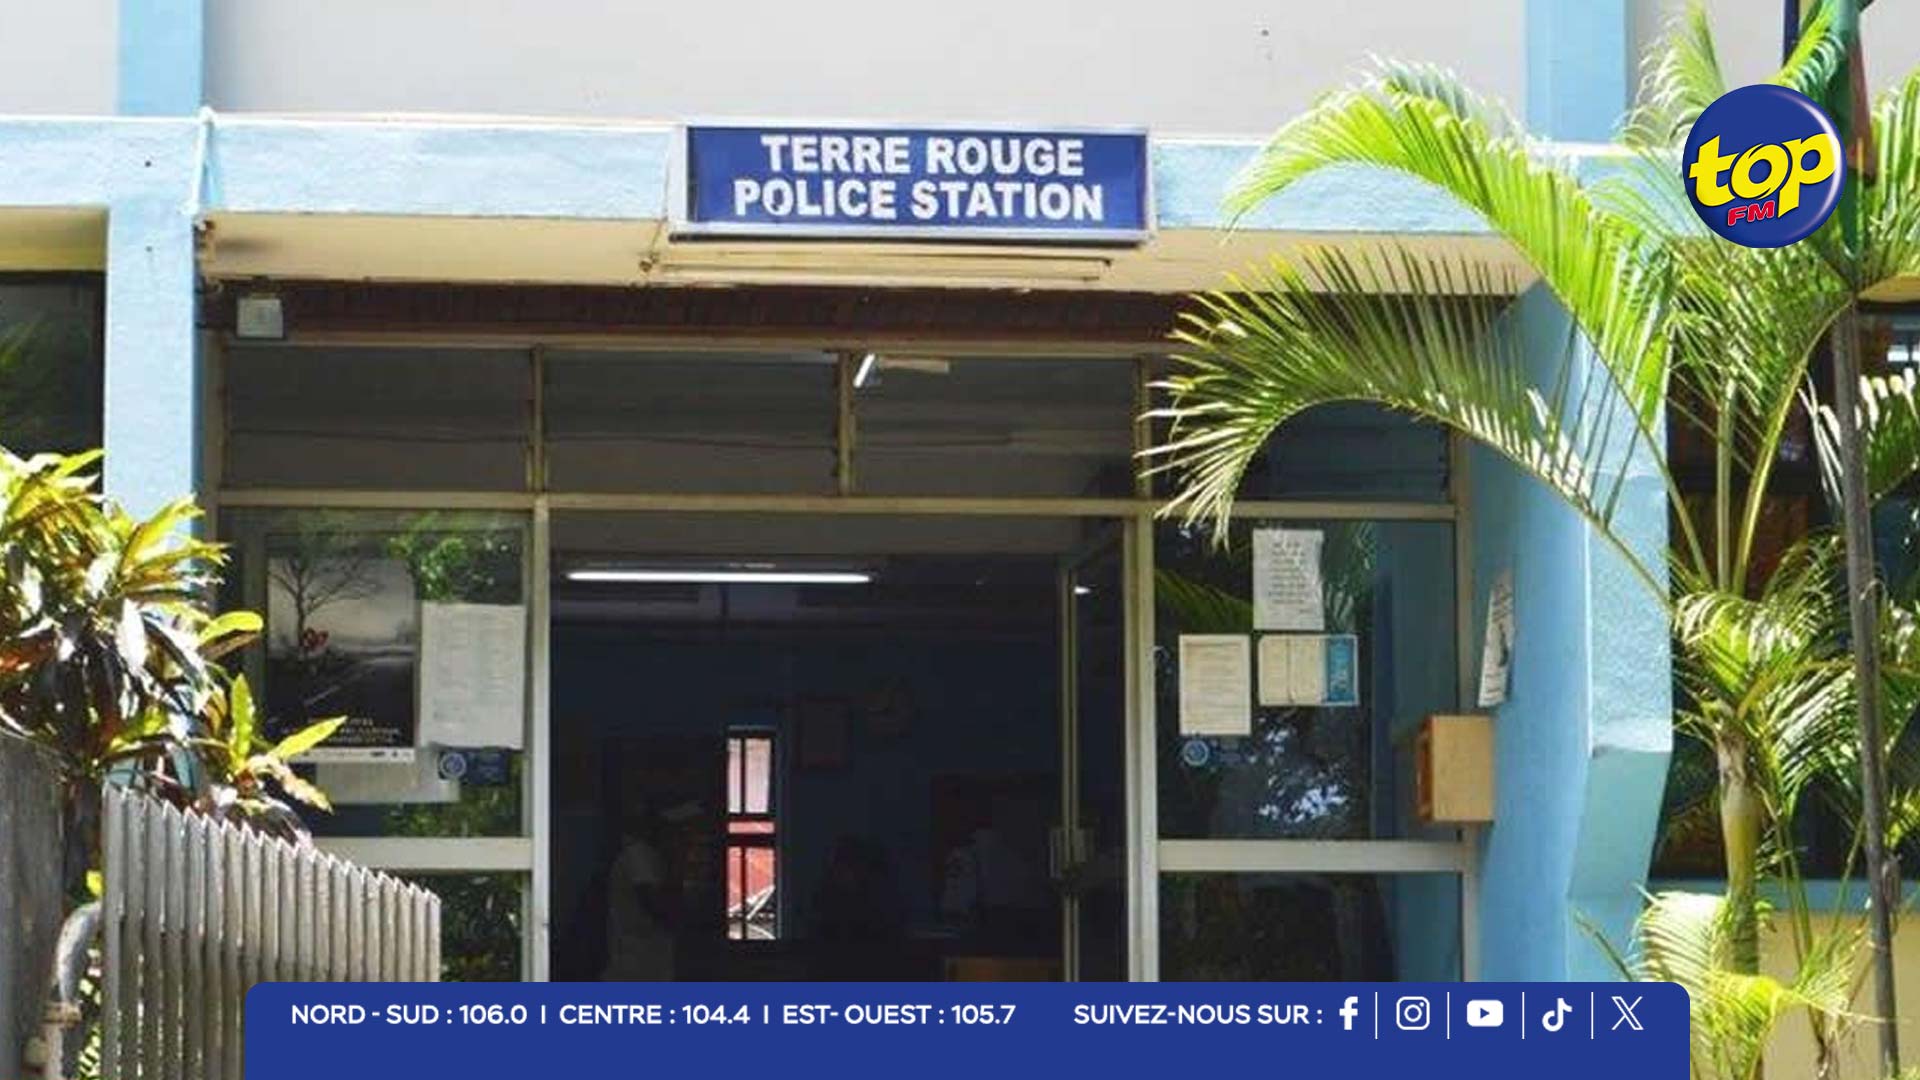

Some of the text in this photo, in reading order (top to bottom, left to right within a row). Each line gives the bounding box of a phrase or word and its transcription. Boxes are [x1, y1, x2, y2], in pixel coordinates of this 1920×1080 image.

[760, 134, 1084, 177] TERRE ROUGE
[734, 178, 1103, 221] POLICE STATION
